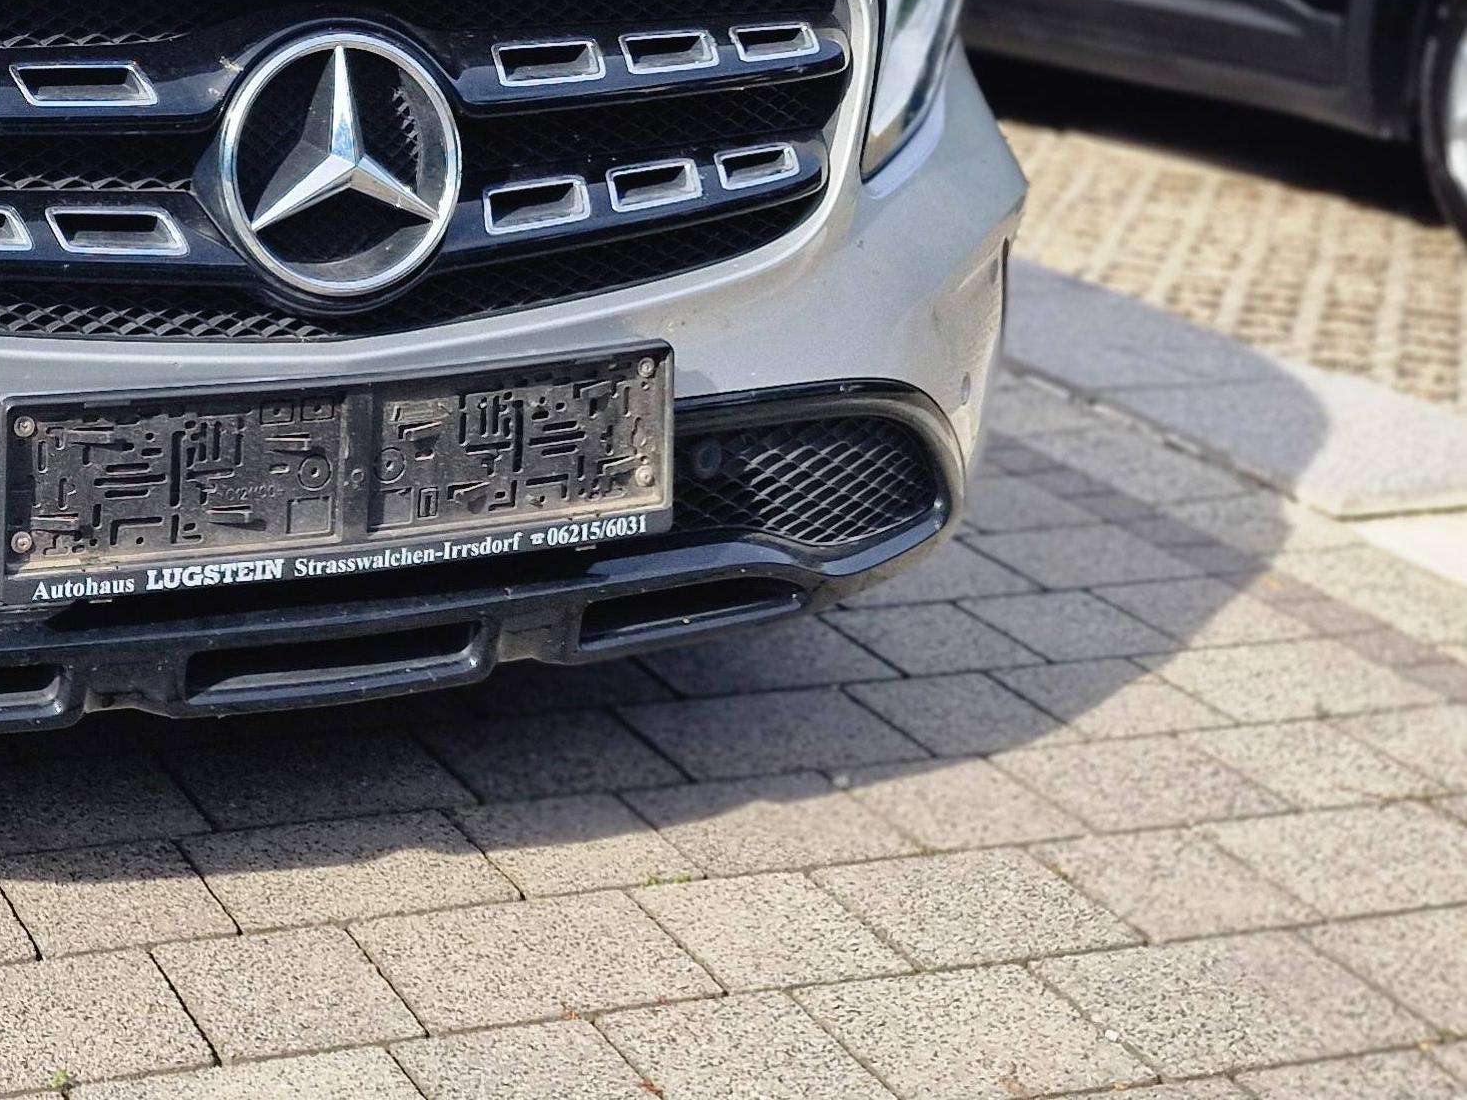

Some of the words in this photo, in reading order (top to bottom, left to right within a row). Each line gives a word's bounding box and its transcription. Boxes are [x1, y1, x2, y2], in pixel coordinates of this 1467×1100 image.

[32, 577, 135, 601] Autohaus
[146, 559, 284, 591] LUGSTEIN
[294, 531, 523, 577] Strasswalchen-Irrsdorf
[547, 514, 648, 547] 06215/6031
